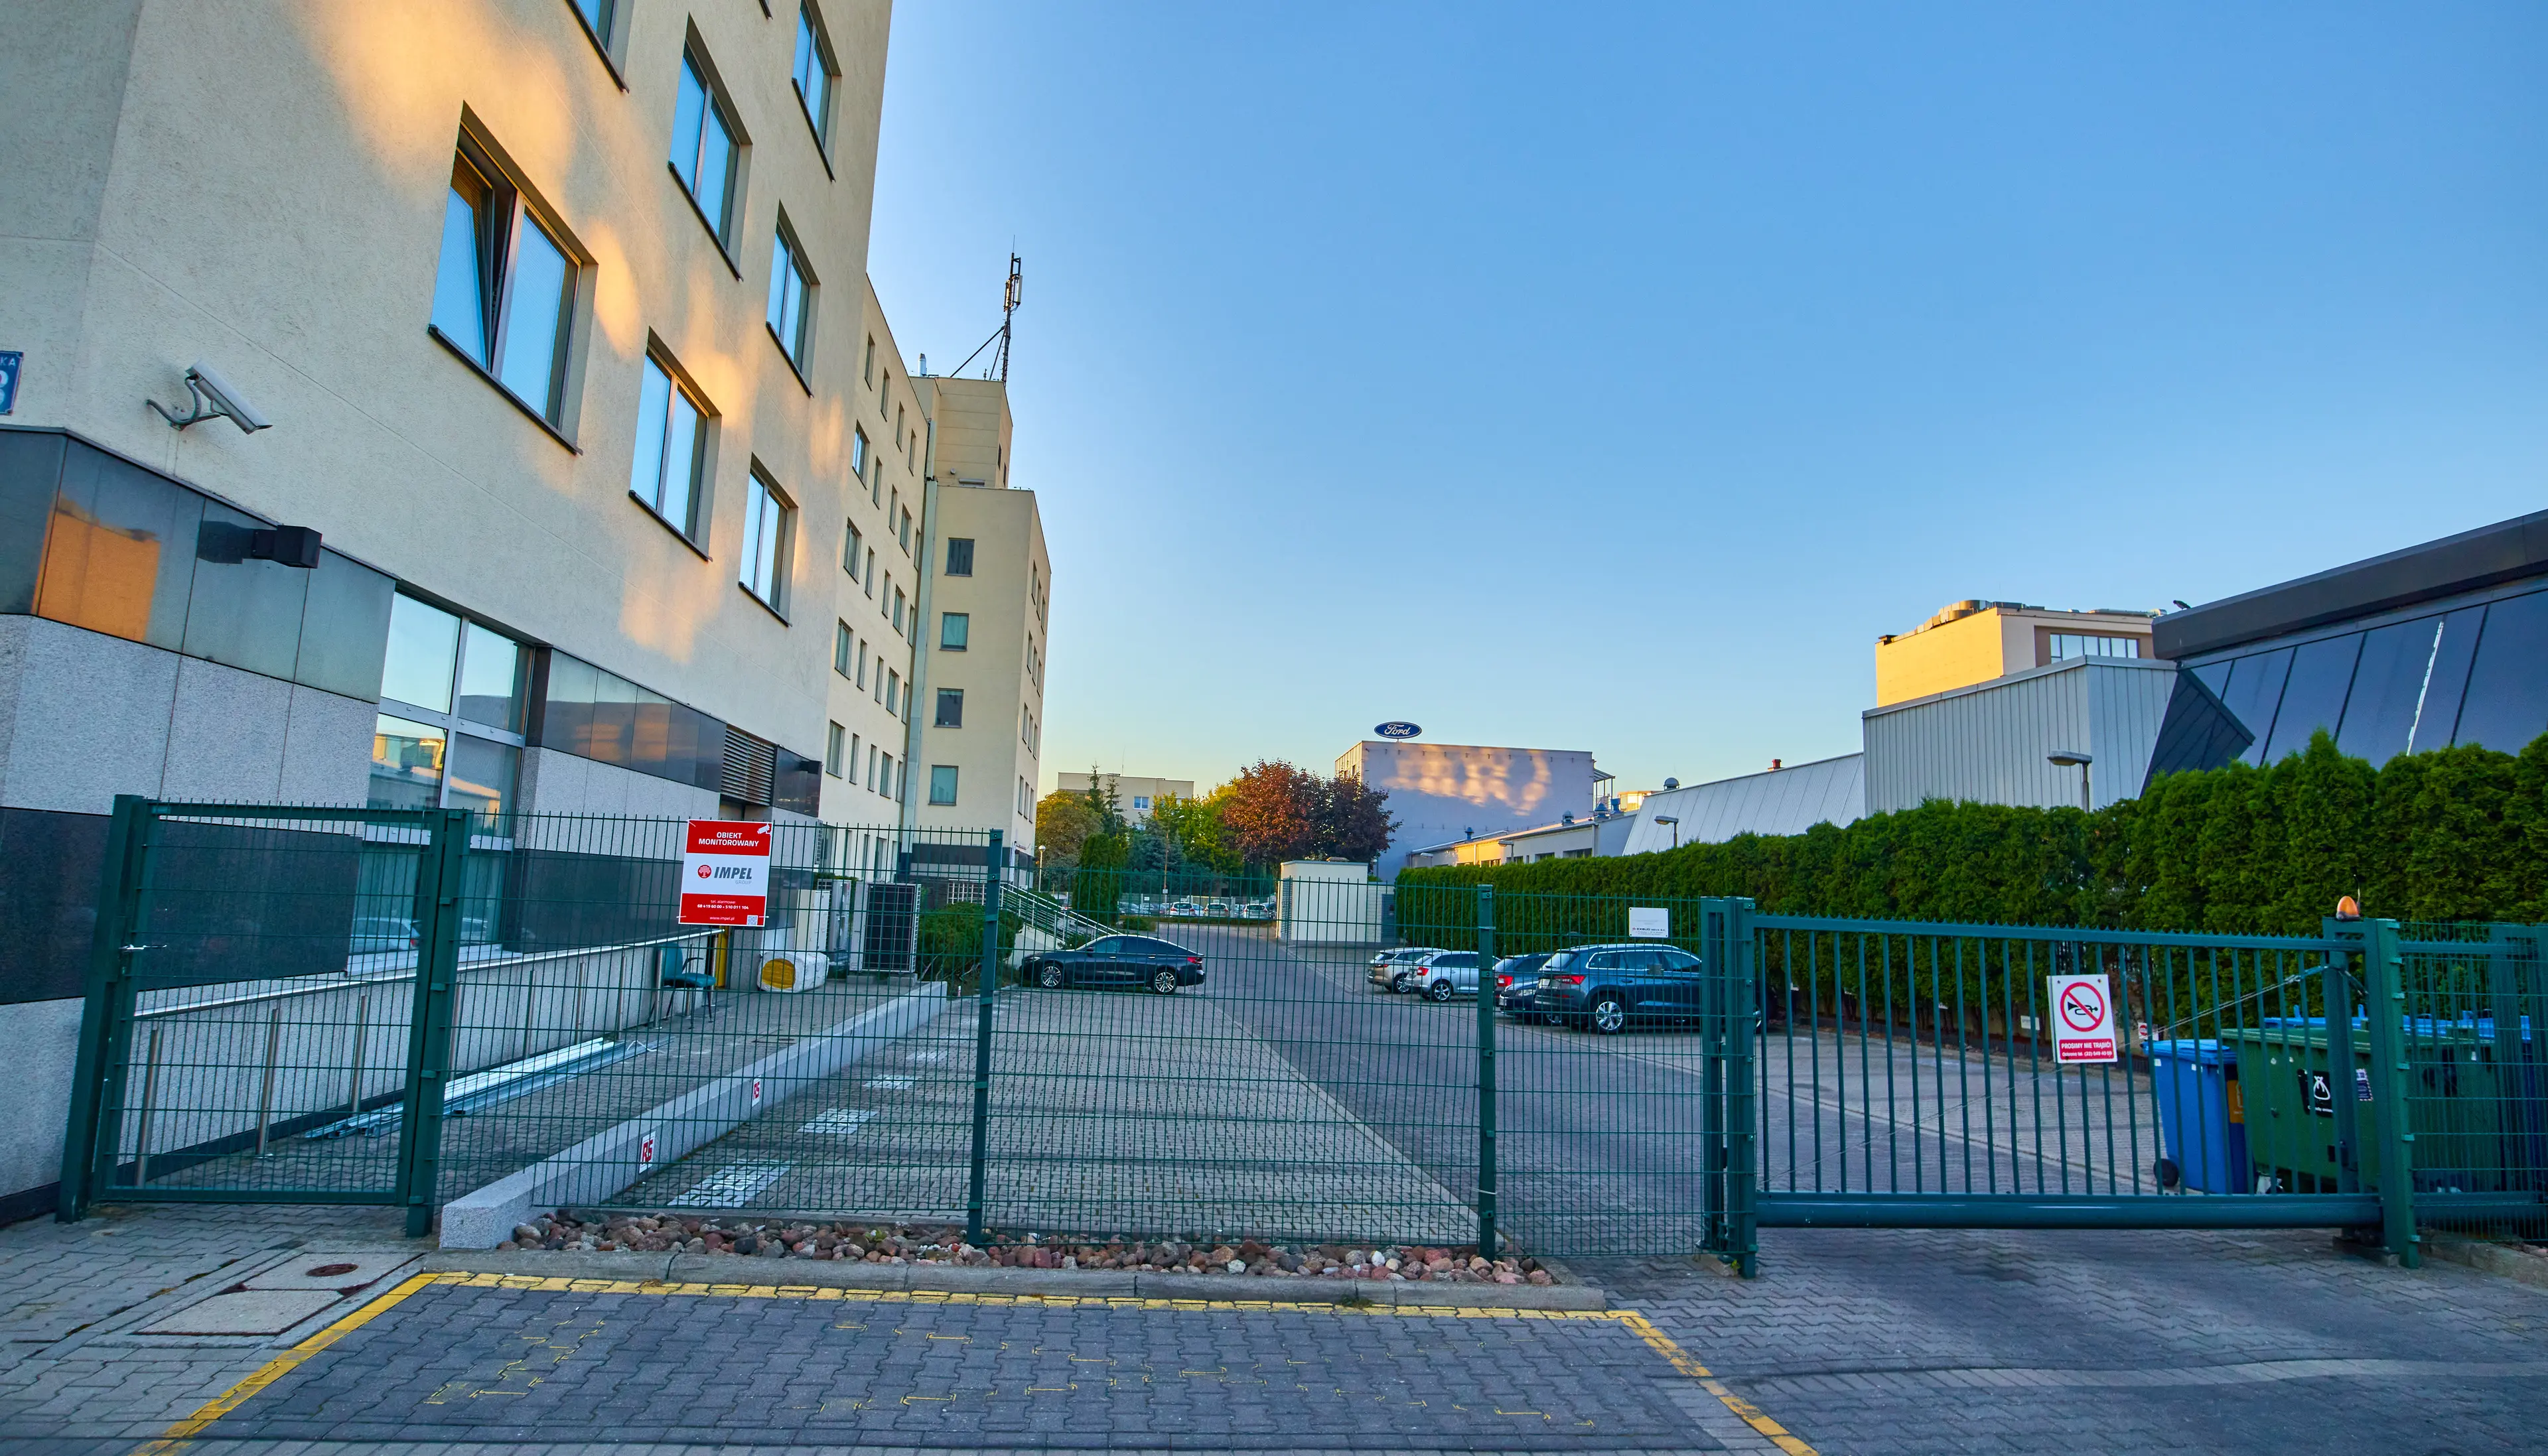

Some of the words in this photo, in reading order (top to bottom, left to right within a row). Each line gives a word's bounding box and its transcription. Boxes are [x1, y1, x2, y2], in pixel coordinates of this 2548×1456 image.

[1384, 724, 1411, 735] Ford
[699, 838, 759, 847] MONITOROWANY
[714, 867, 752, 880] IMPEL
